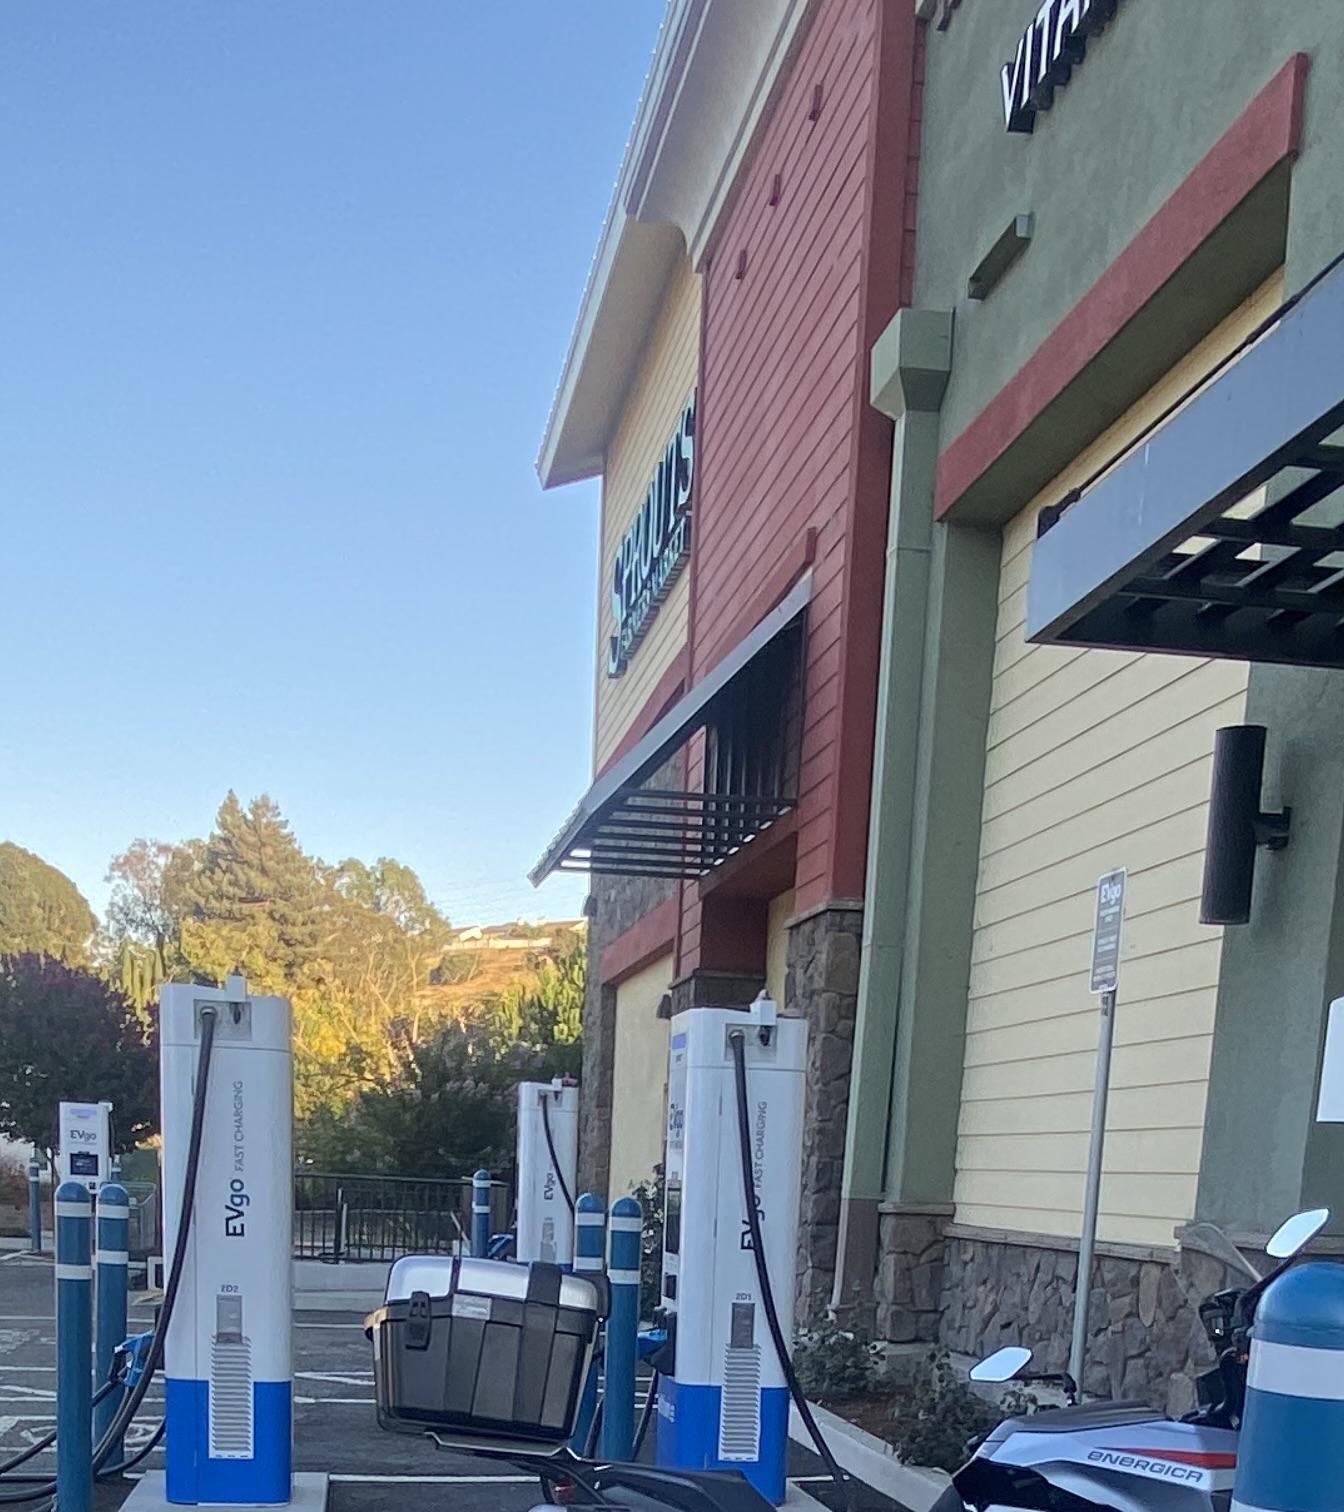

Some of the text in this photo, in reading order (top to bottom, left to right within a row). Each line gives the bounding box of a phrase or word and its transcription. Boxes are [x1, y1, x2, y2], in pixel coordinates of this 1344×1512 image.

[1000, 0, 1090, 132] VITA
[225, 1080, 250, 1238] EVgo FAST CHARGING
[754, 1101, 768, 1160] CHARGING
